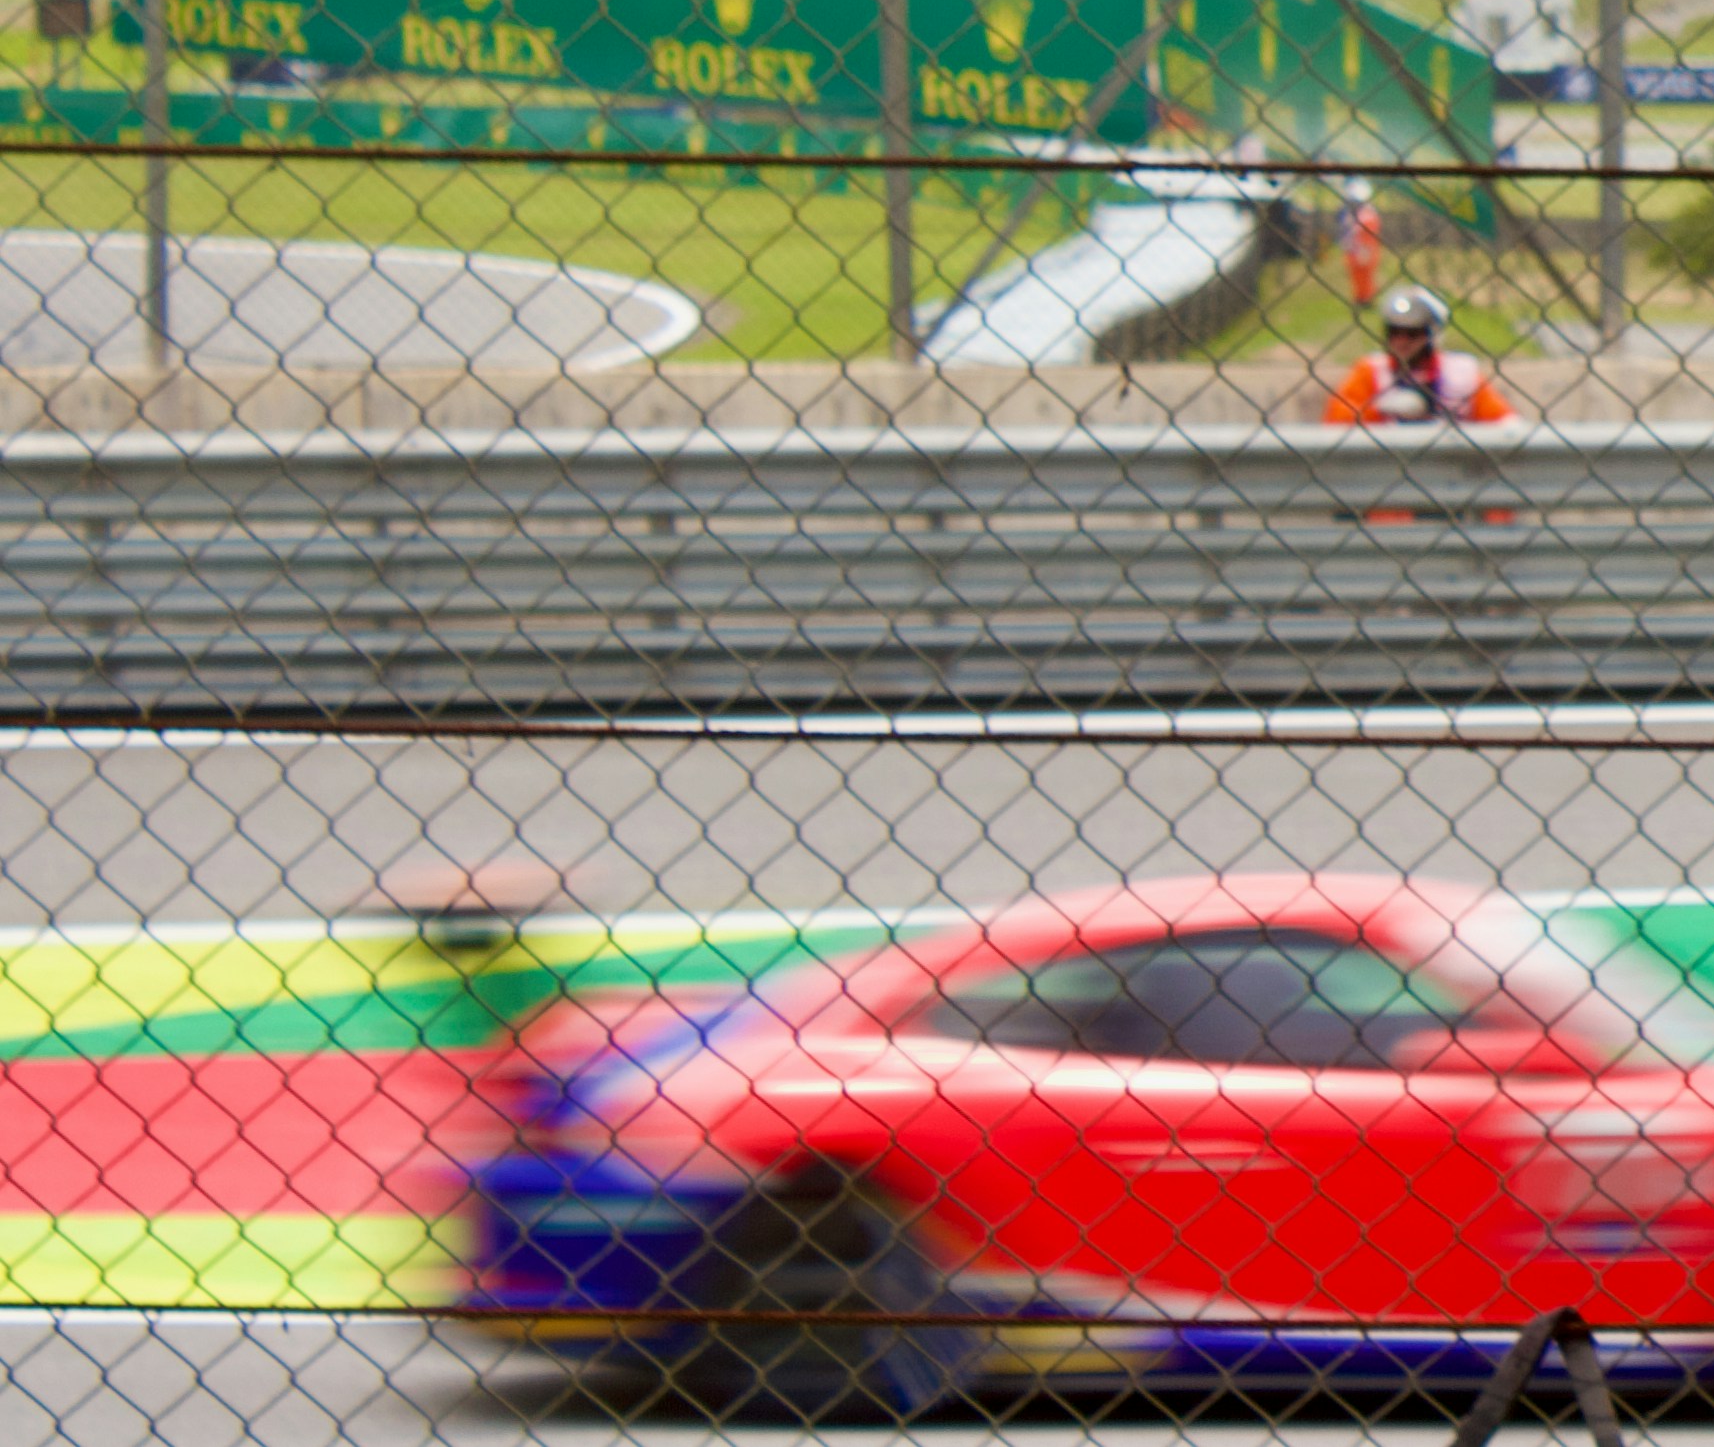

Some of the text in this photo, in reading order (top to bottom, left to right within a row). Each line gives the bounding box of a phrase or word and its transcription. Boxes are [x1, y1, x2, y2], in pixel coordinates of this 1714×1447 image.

[401, 11, 561, 79] ROLEX
[650, 34, 819, 105] ROLEX
[917, 62, 1092, 132] ROLEX
